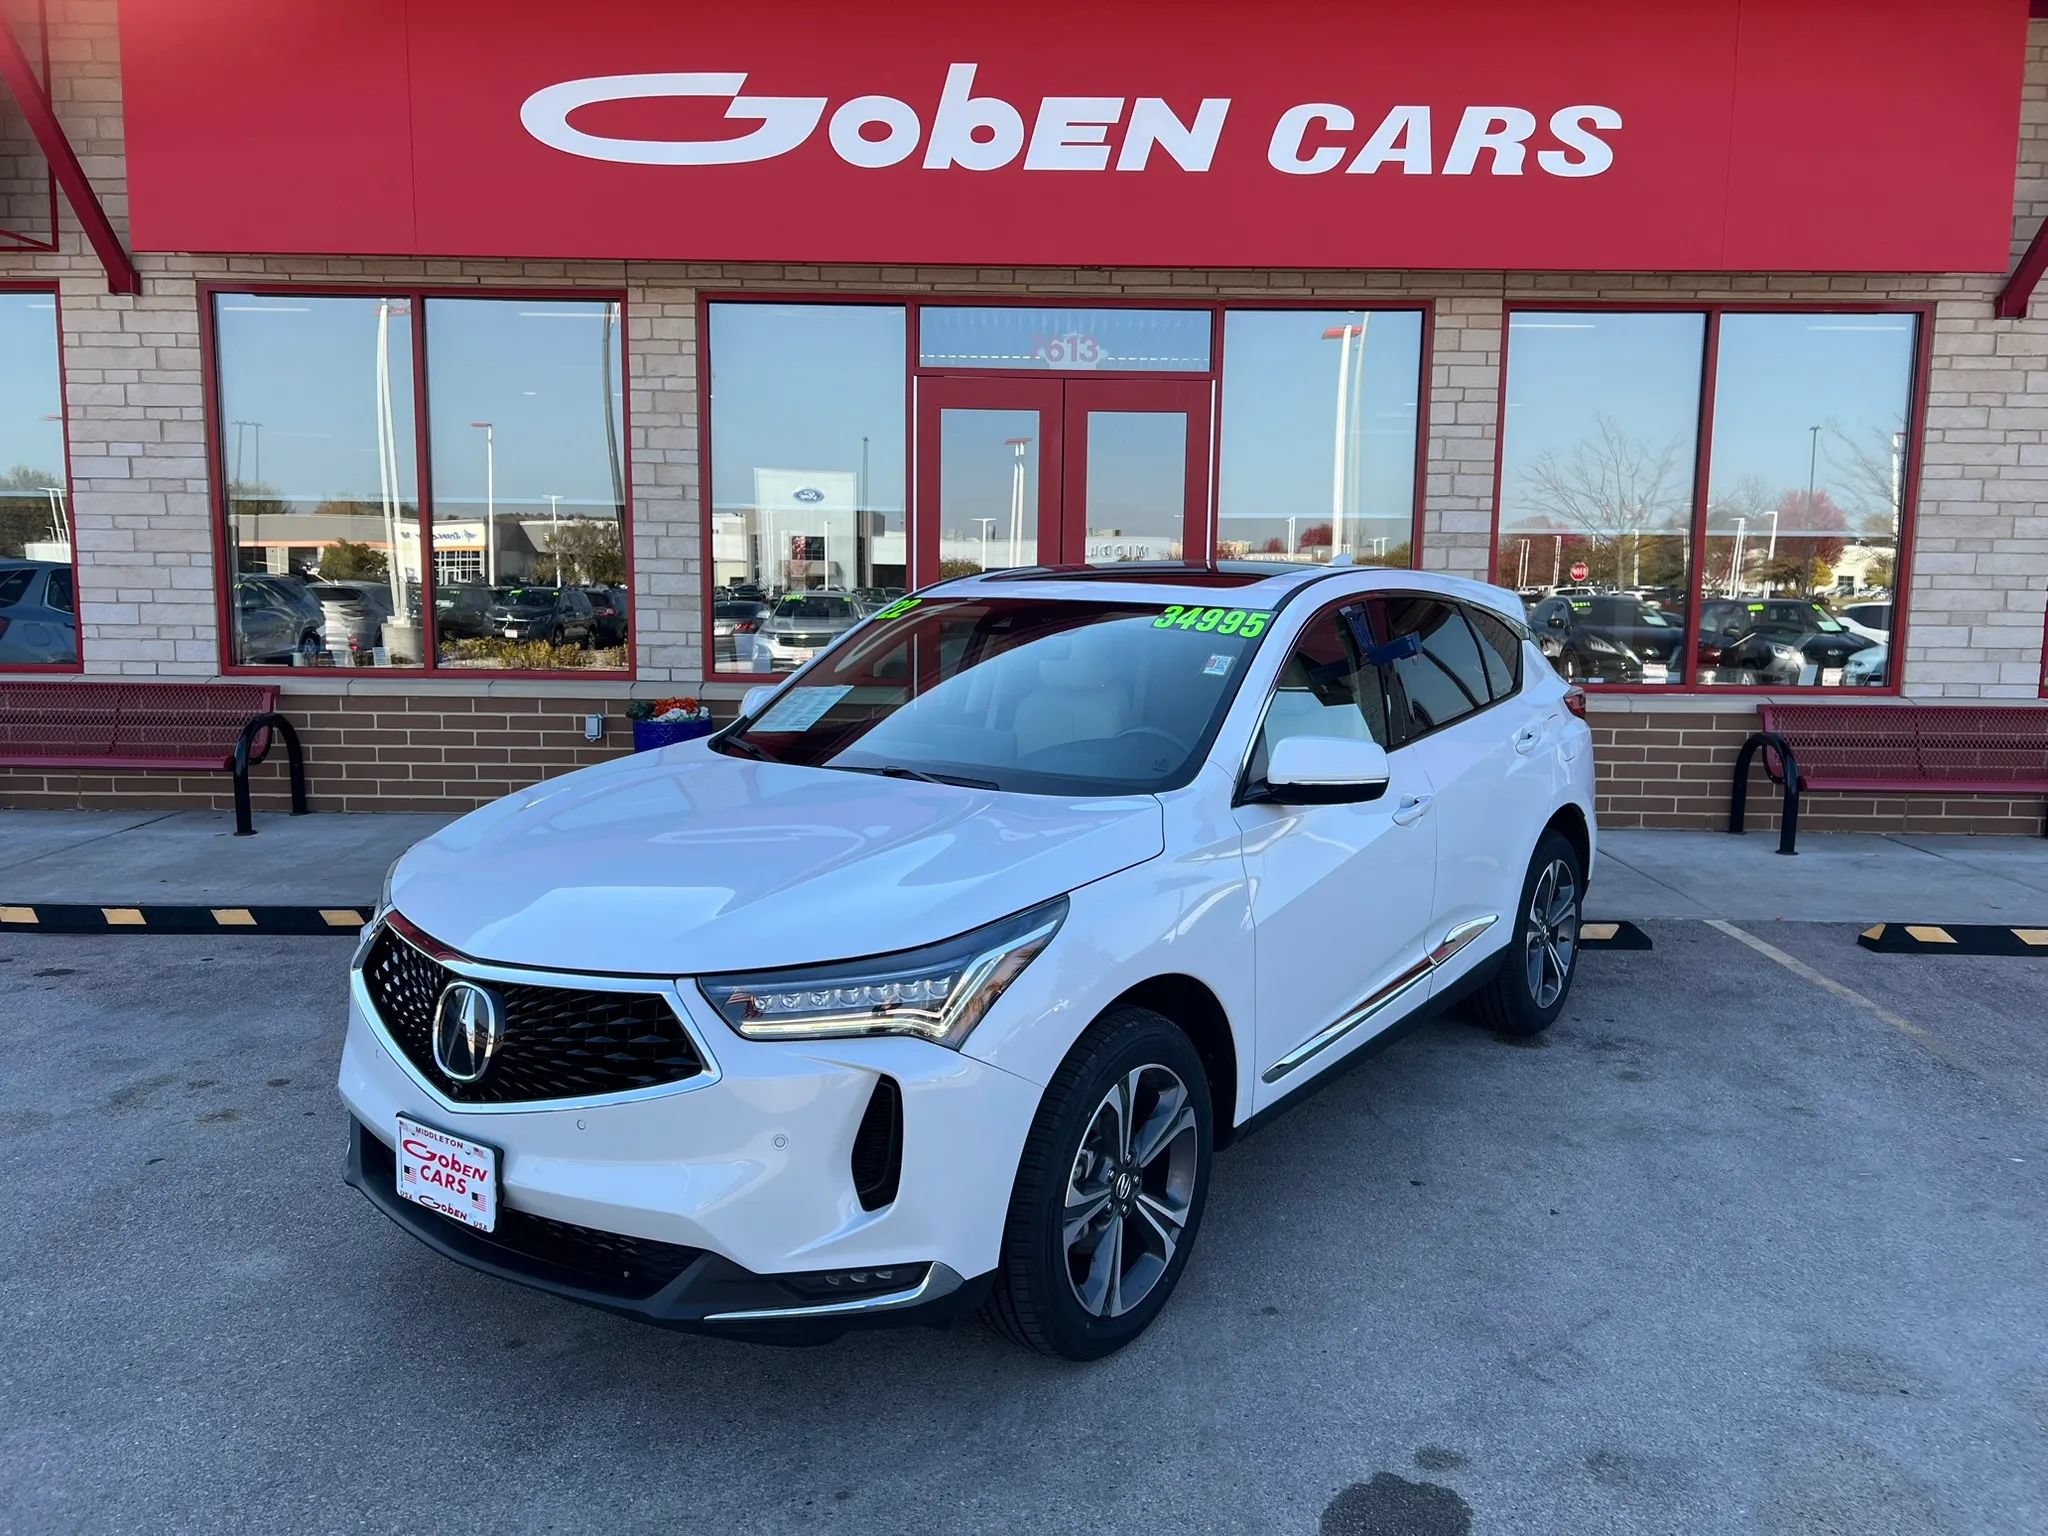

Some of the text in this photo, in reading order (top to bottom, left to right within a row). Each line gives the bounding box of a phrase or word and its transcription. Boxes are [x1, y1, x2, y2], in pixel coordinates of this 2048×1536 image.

[520, 63, 1623, 177] GobEN CARS
[1028, 335, 1099, 363] 7613
[1152, 605, 1272, 638] 34995
[415, 1126, 464, 1149] MIDDLETON
[402, 1139, 488, 1182] GobEN
[420, 1165, 467, 1195] CARS
[473, 1220, 488, 1231] USA
